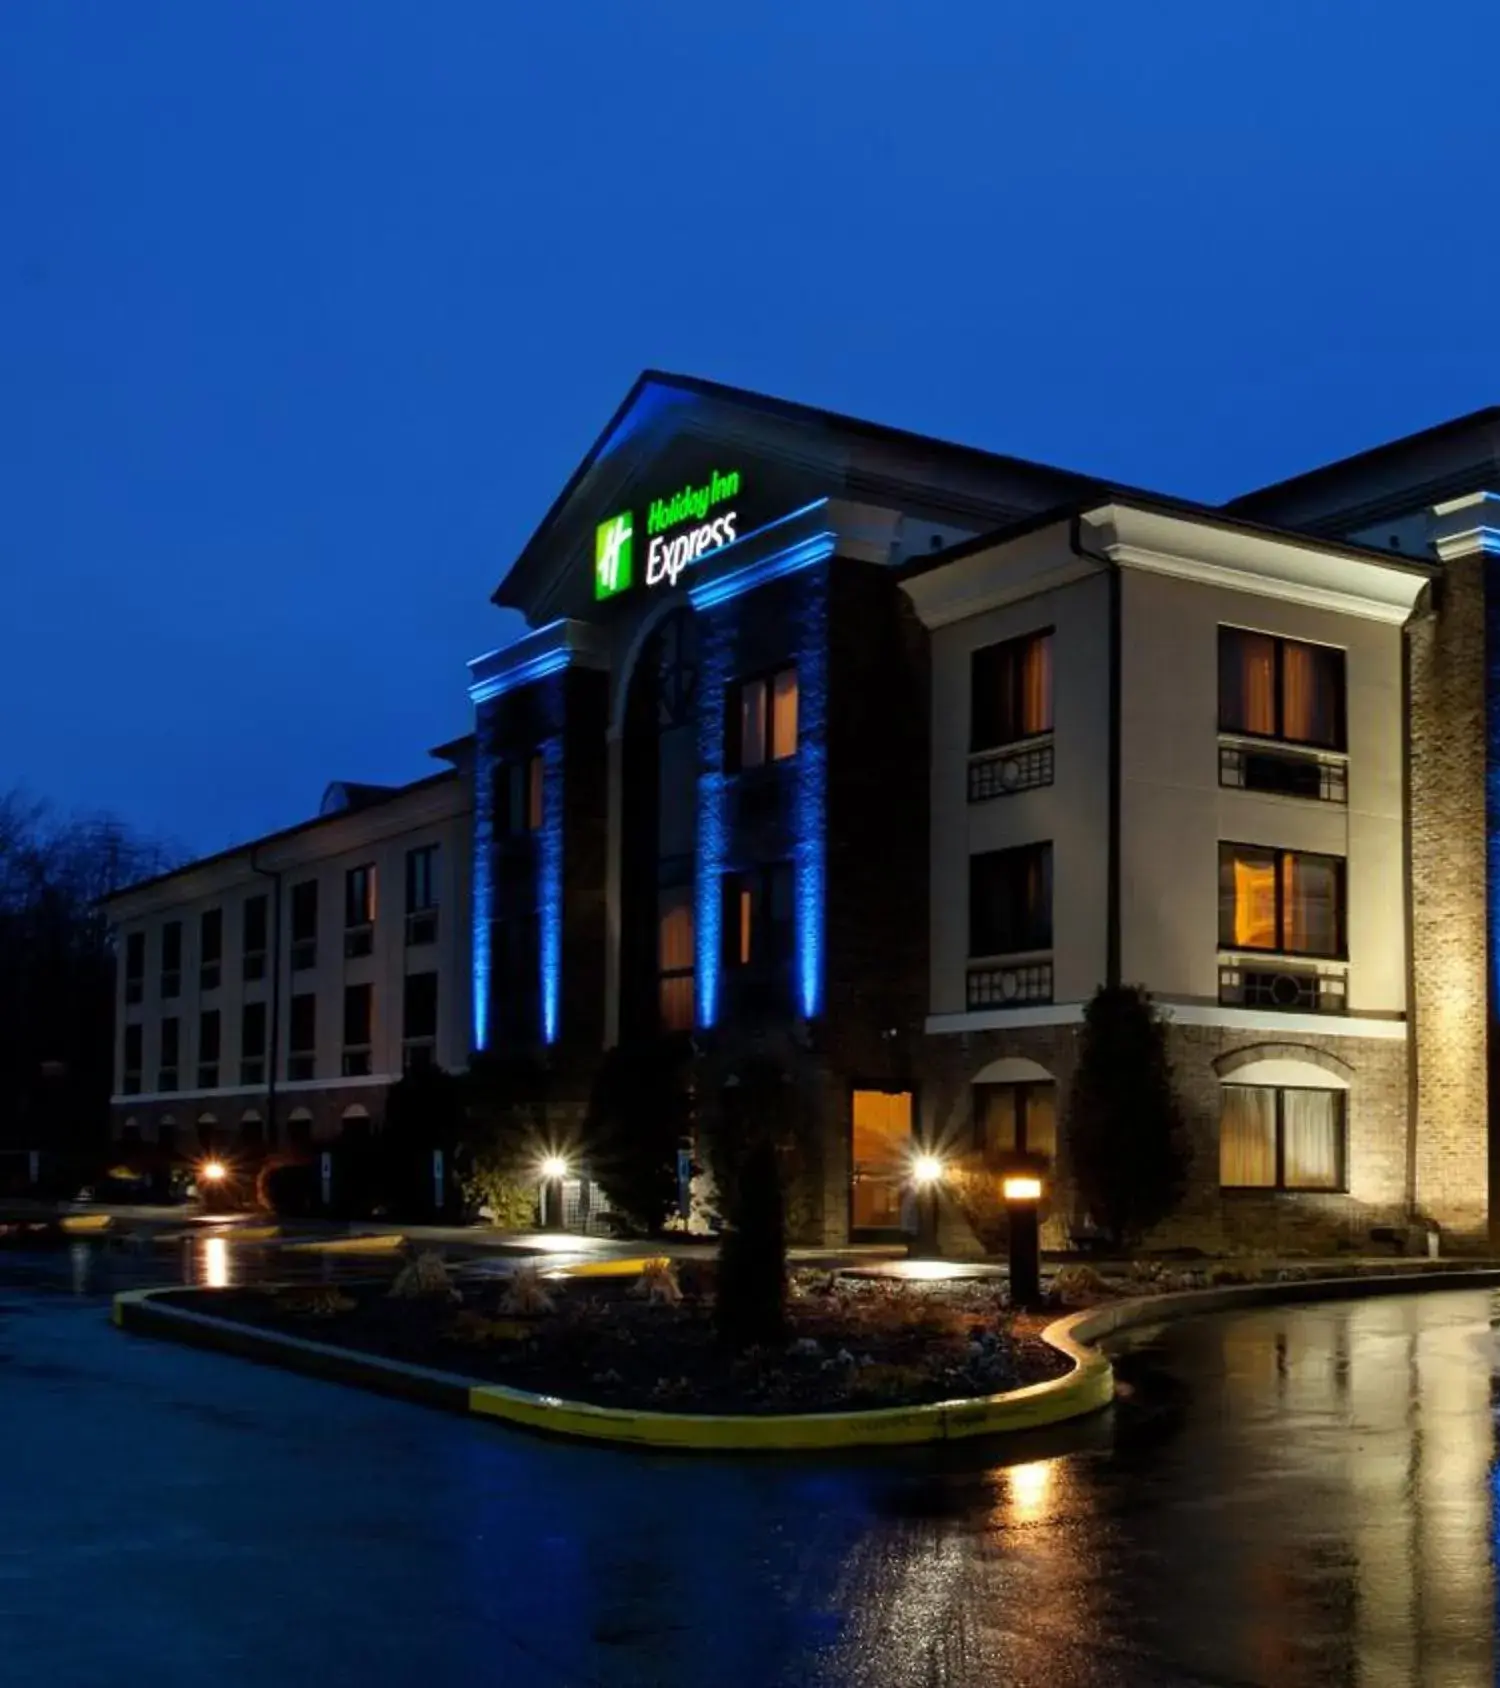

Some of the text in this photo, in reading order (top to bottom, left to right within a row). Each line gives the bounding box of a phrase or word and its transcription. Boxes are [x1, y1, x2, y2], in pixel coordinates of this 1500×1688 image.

[647, 470, 740, 535] Holiday Inn
[646, 511, 737, 586] Express
